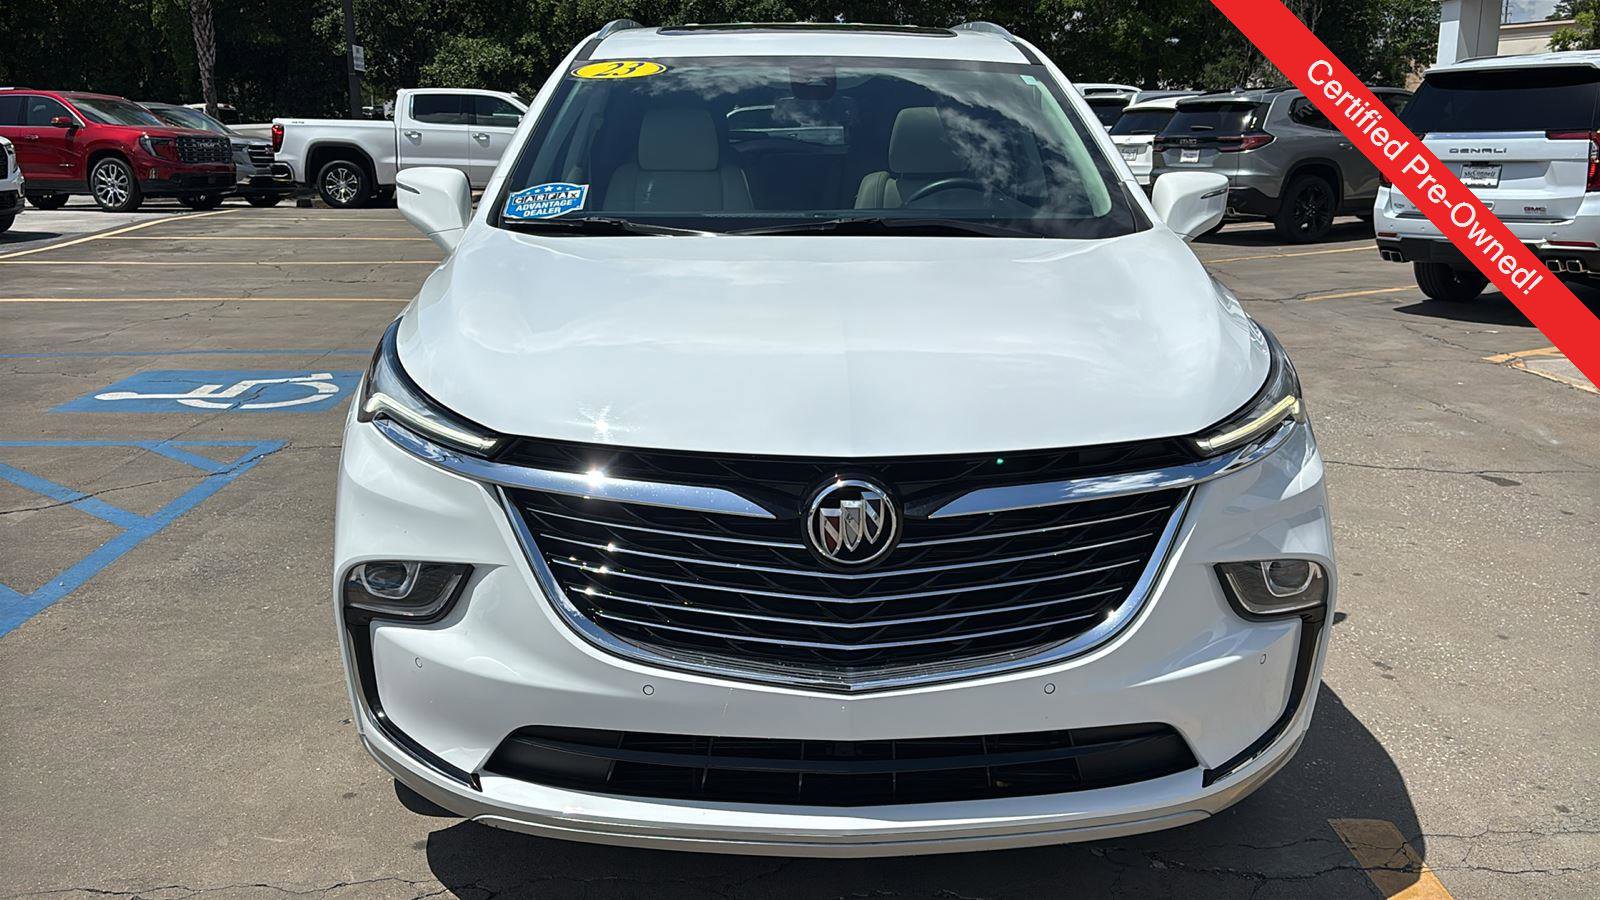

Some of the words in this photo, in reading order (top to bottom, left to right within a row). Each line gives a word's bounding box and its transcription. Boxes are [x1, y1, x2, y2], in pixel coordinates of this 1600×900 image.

[592, 62, 645, 77] 23
[514, 190, 580, 205] CARFAX
[515, 199, 573, 212] ADVANTAGE
[523, 207, 562, 217] DEALER
